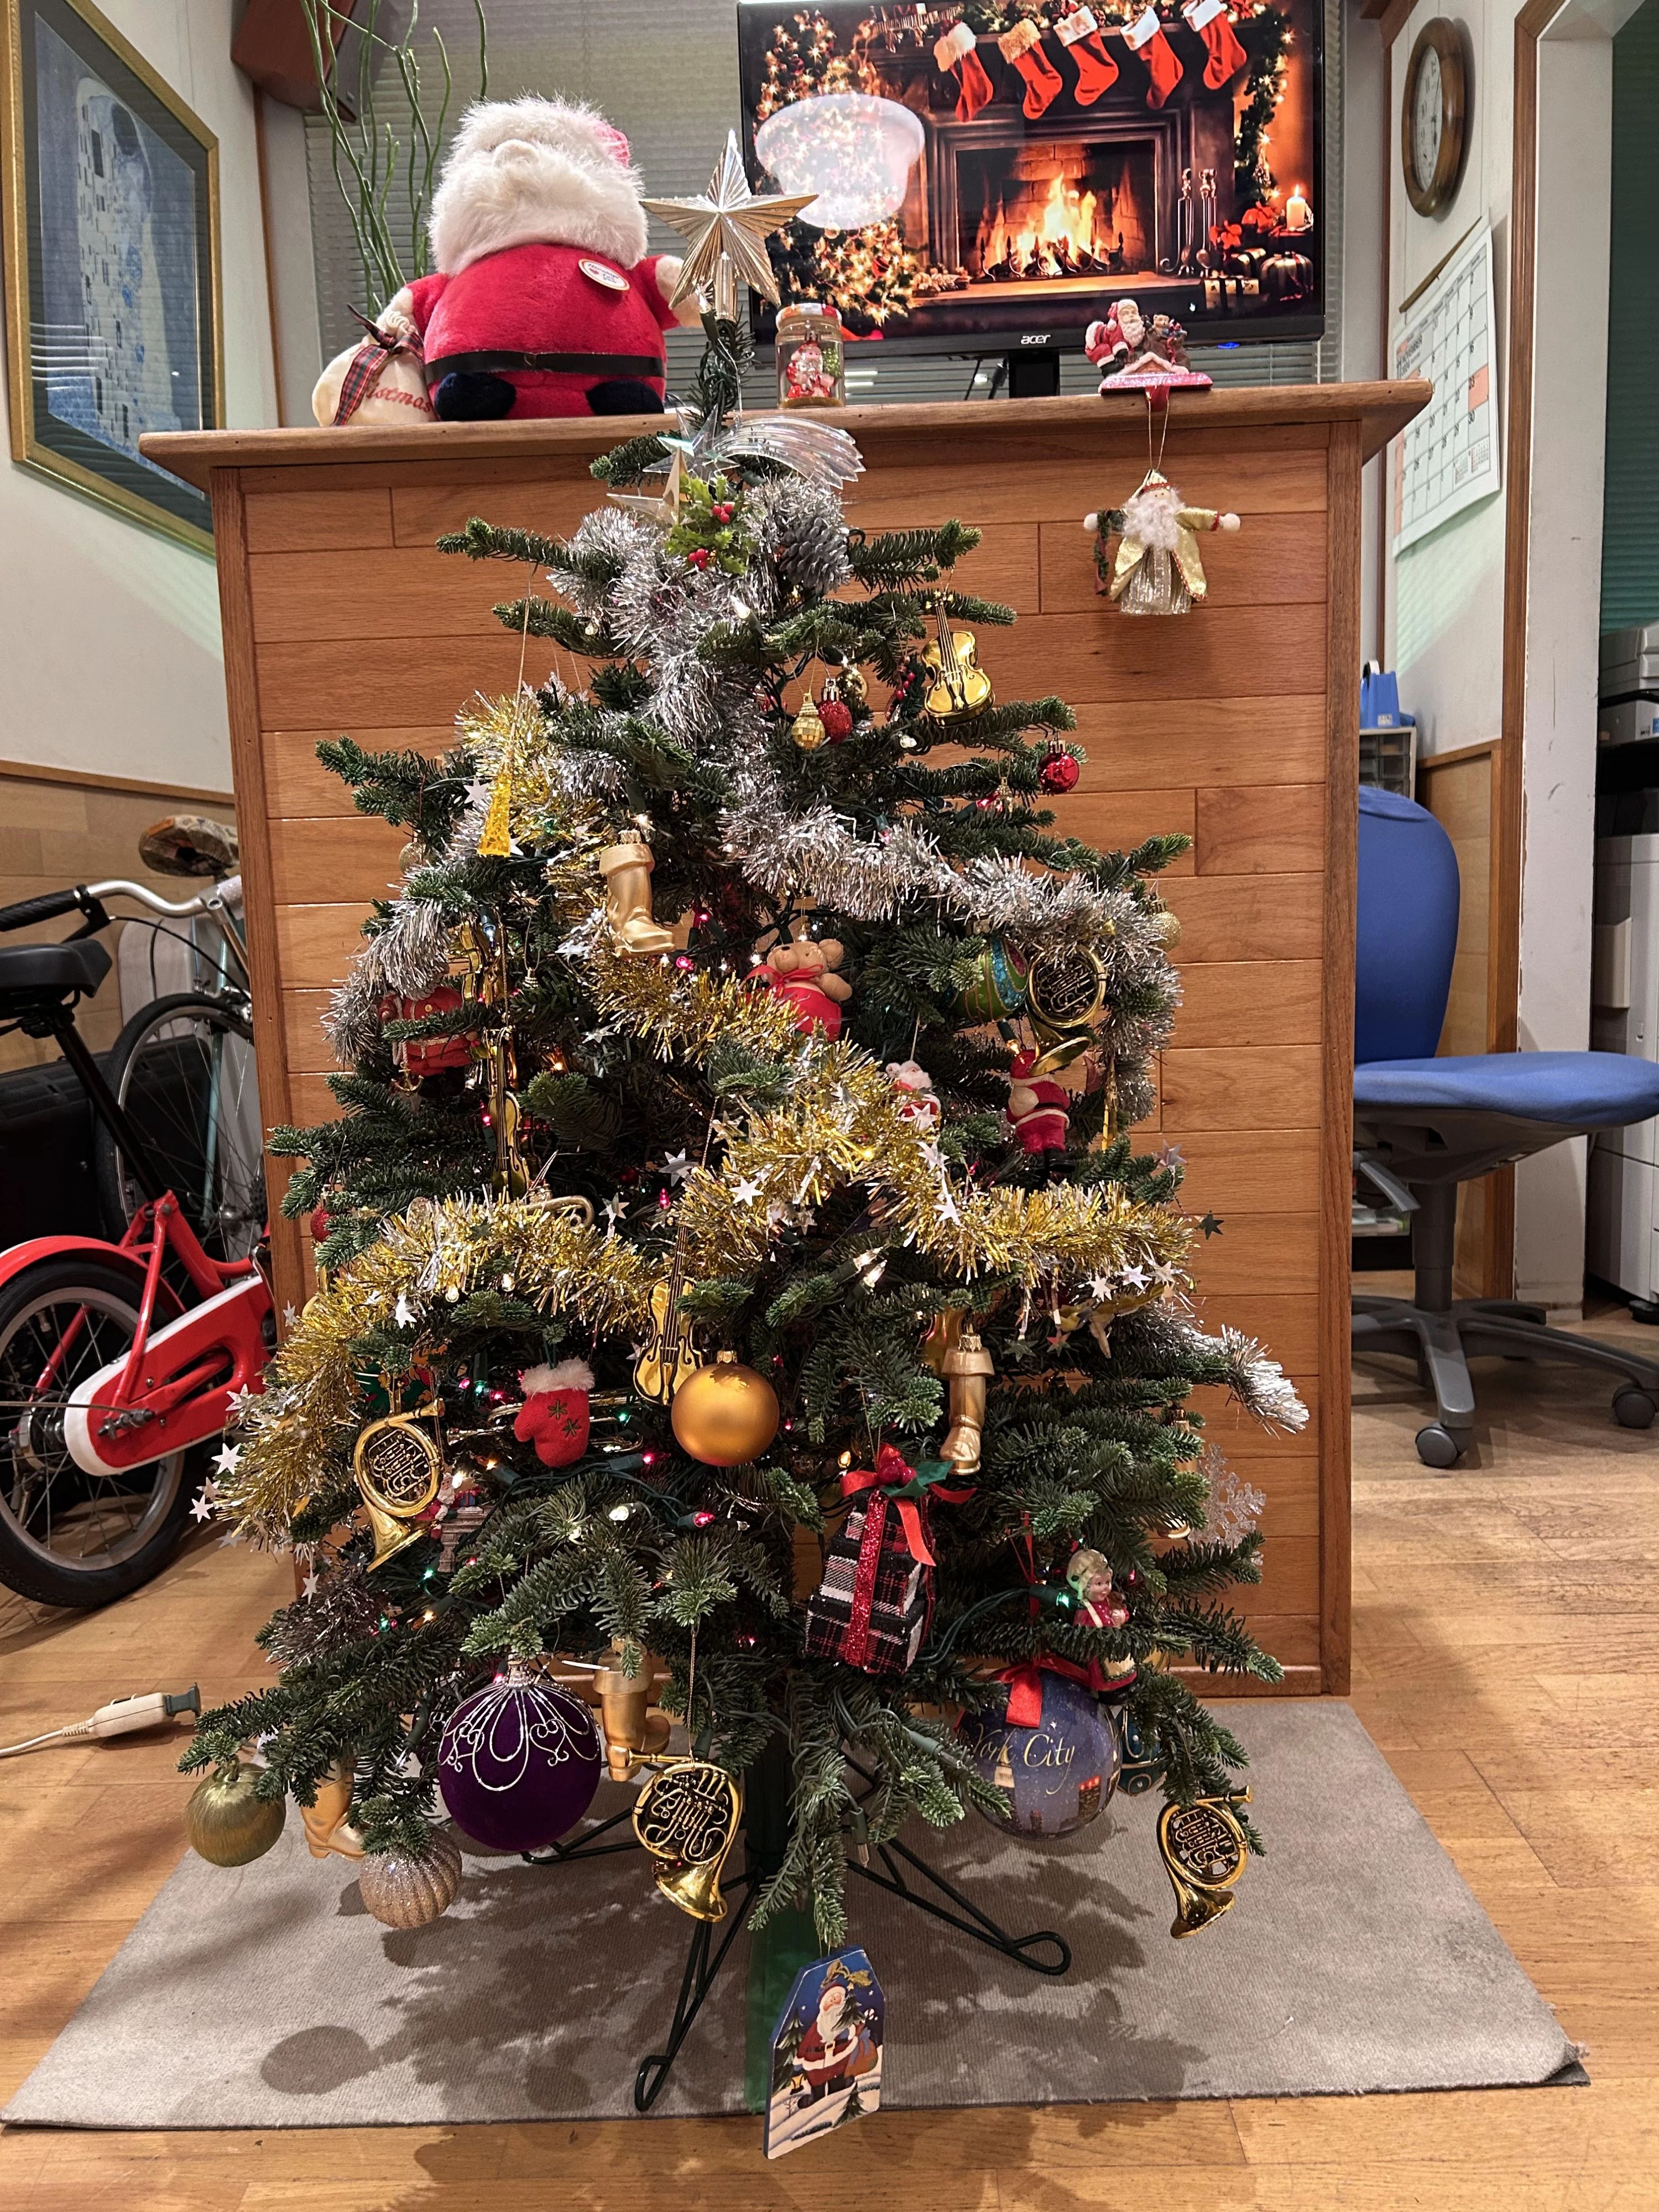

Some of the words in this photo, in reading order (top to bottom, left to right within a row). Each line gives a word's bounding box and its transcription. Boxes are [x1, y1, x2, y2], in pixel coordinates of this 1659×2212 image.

[1020, 335, 1051, 344] acer
[365, 382, 431, 413] istmas
[1024, 1734, 1075, 1795] City
